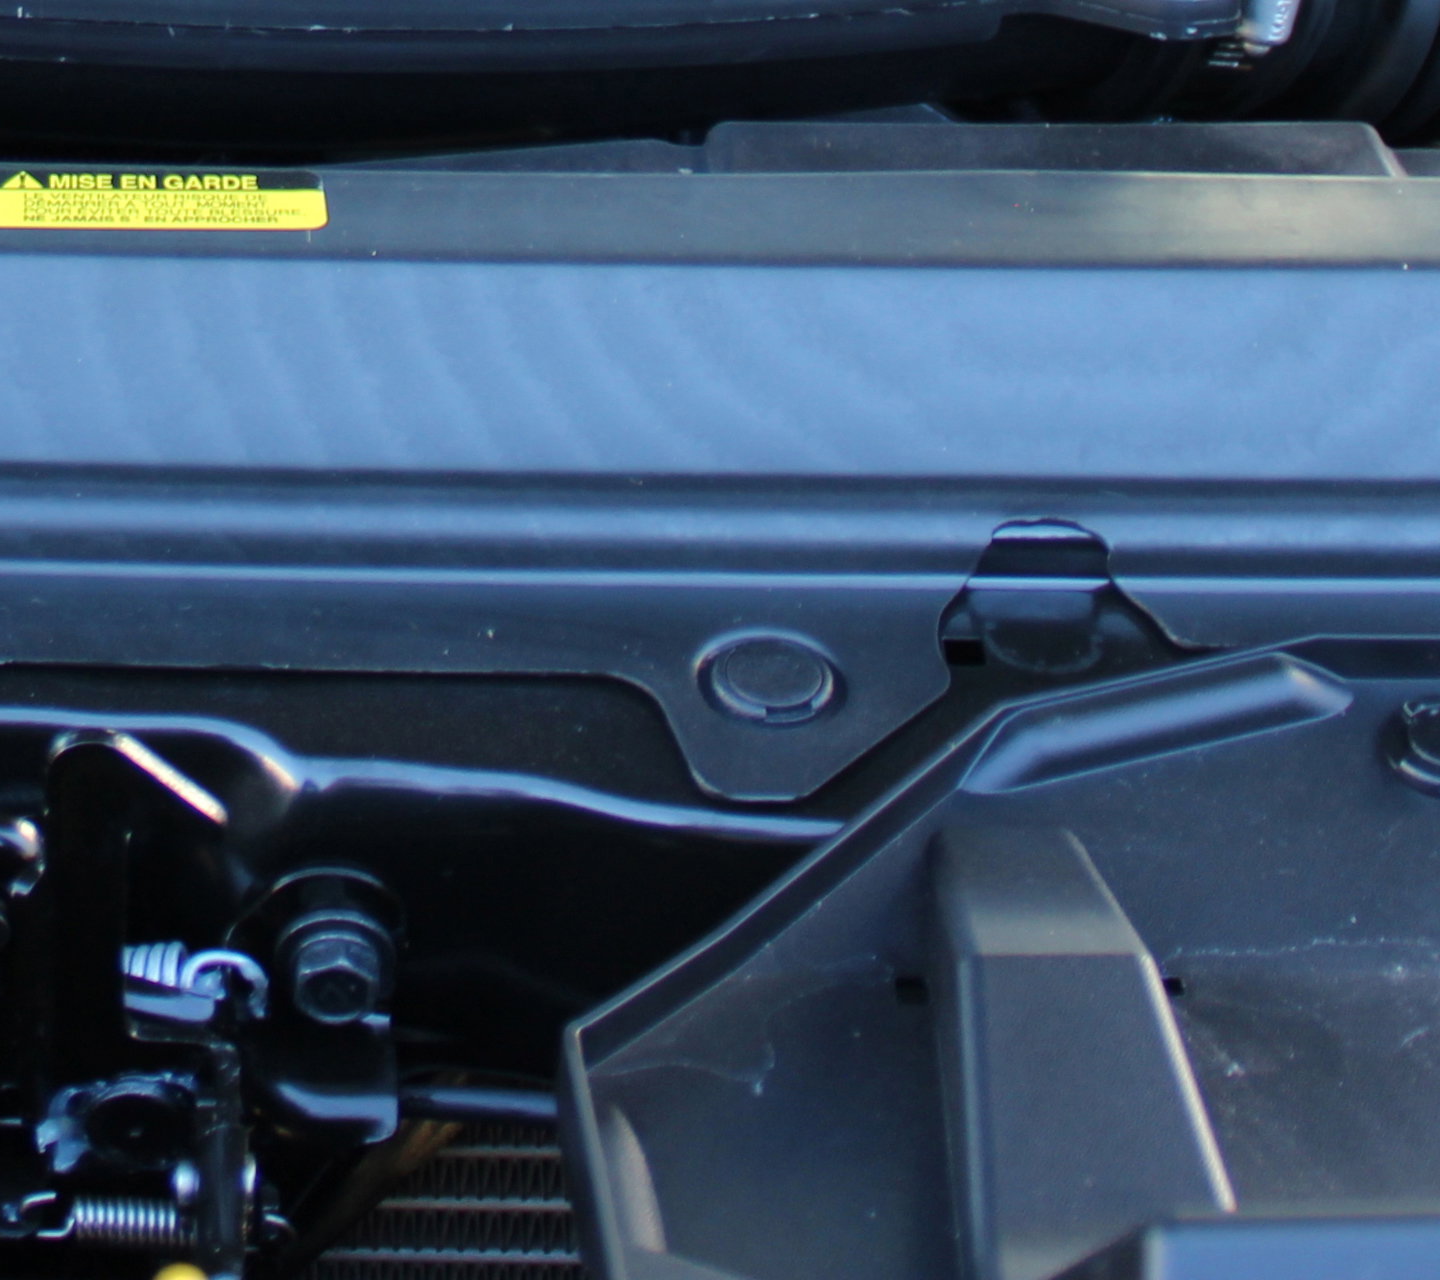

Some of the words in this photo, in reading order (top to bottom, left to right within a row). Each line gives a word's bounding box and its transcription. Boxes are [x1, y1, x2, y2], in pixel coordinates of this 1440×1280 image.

[49, 173, 114, 189] MISE
[120, 174, 157, 189] EN
[163, 175, 259, 190] GARDE
[49, 193, 167, 201] VENTILATEUR
[23, 207, 72, 215] POUR
[148, 207, 203, 215] TOUTE
[51, 215, 115, 223] JAMAIS
[171, 216, 280, 224] APPROCHER
